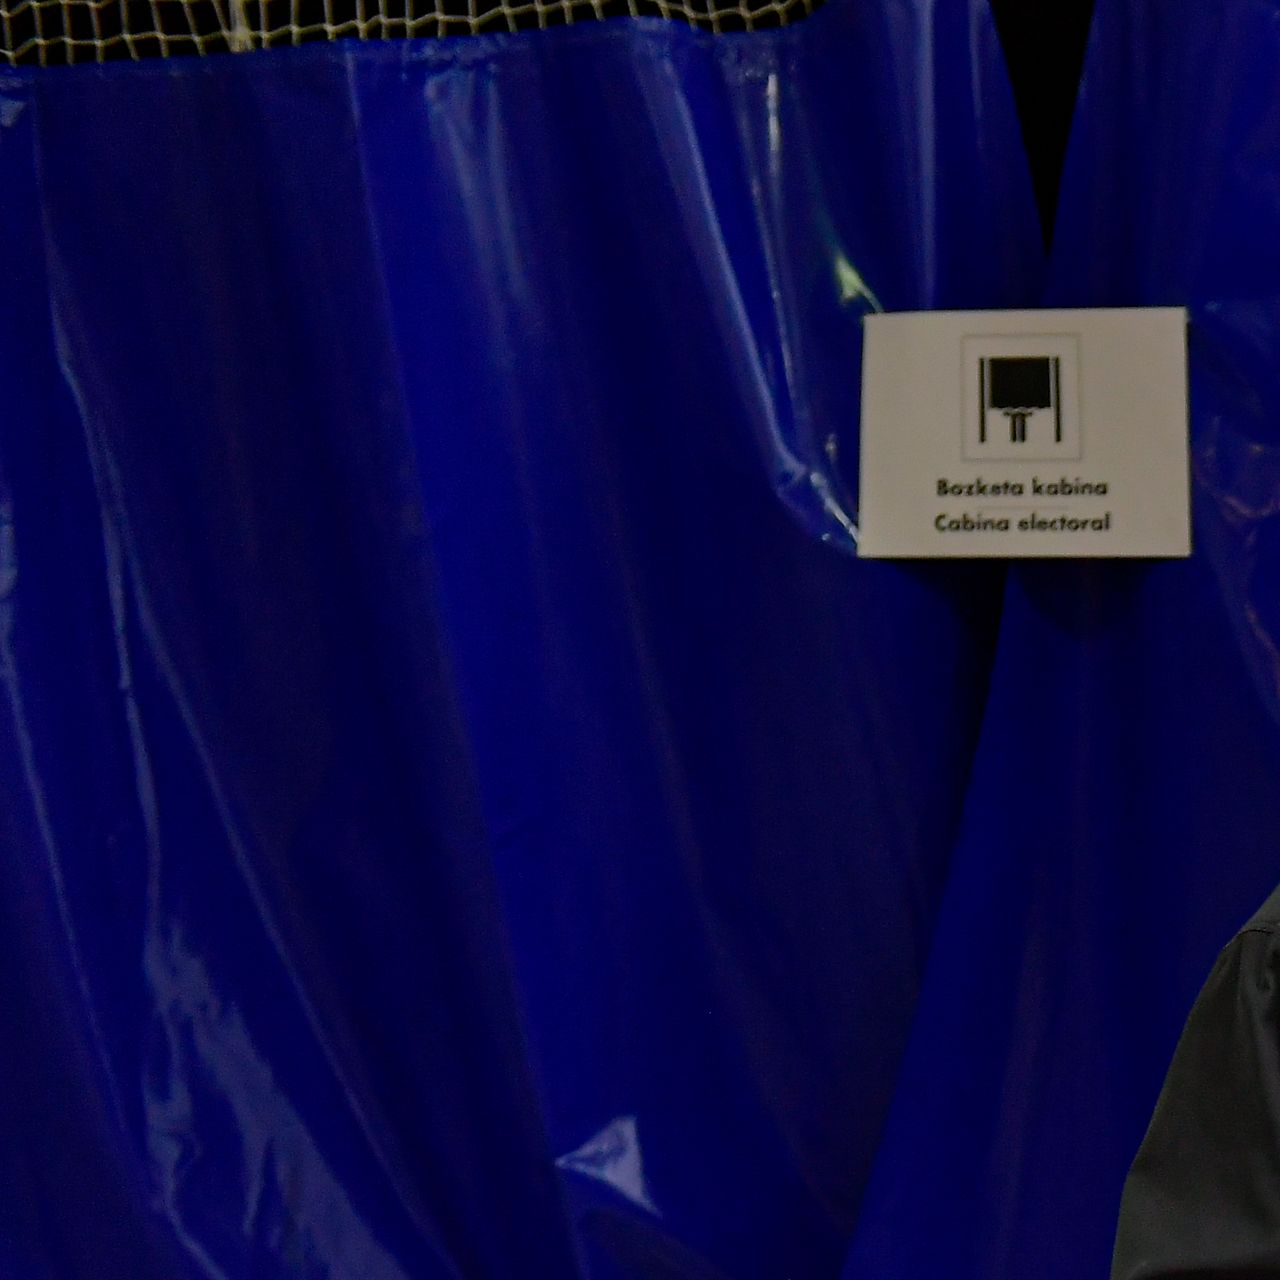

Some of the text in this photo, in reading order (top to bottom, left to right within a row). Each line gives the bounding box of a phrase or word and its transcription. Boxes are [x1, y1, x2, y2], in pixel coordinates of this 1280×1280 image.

[936, 475, 1108, 497] Bozketa kabina
[934, 510, 1112, 532] Cabina electoral
